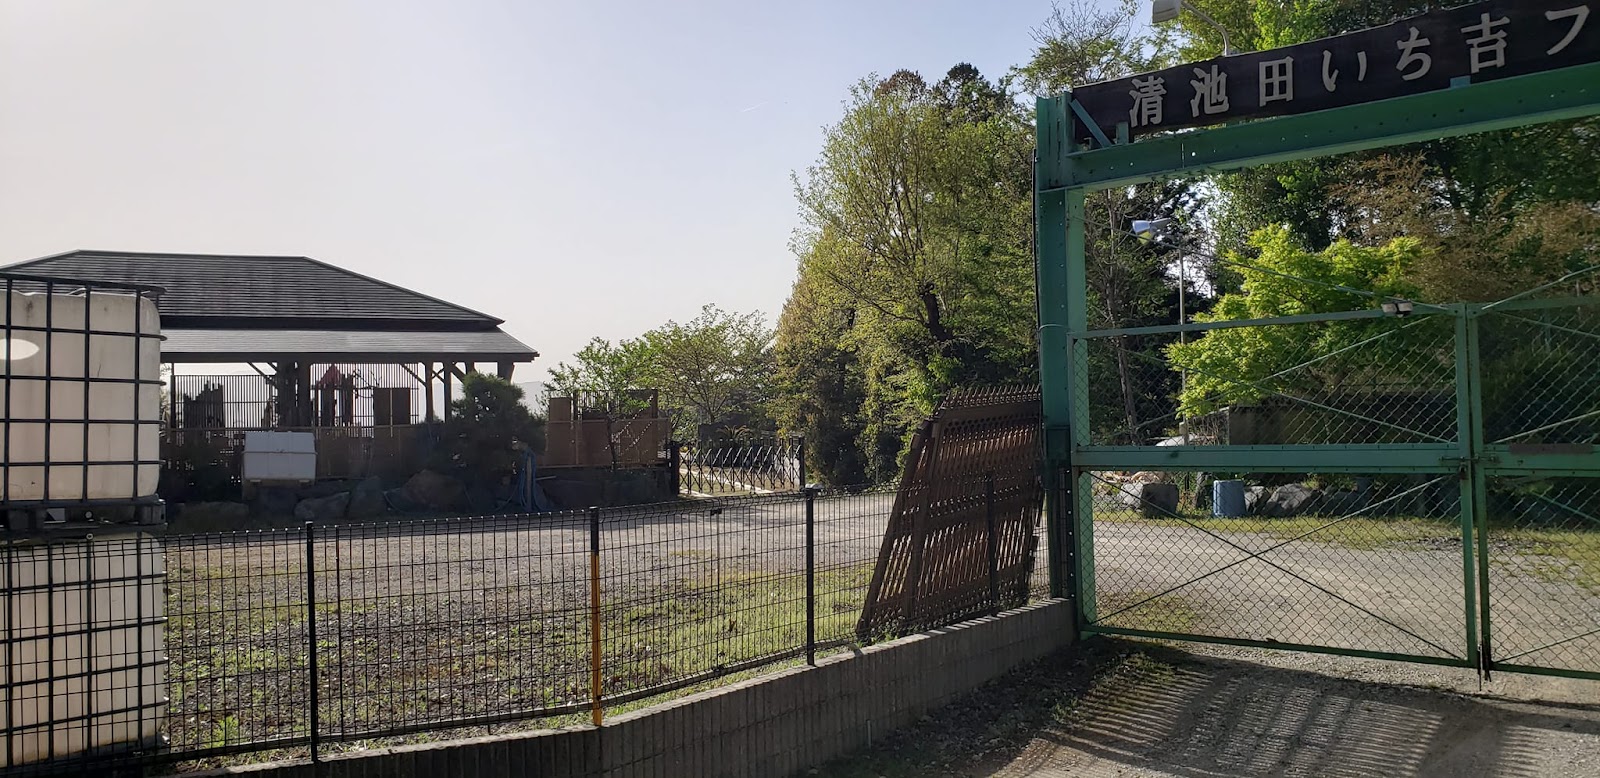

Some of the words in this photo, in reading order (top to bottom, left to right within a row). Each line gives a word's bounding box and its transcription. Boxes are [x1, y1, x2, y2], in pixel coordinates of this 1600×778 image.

[1128, 4, 1590, 128] 清池田いち吉フ
